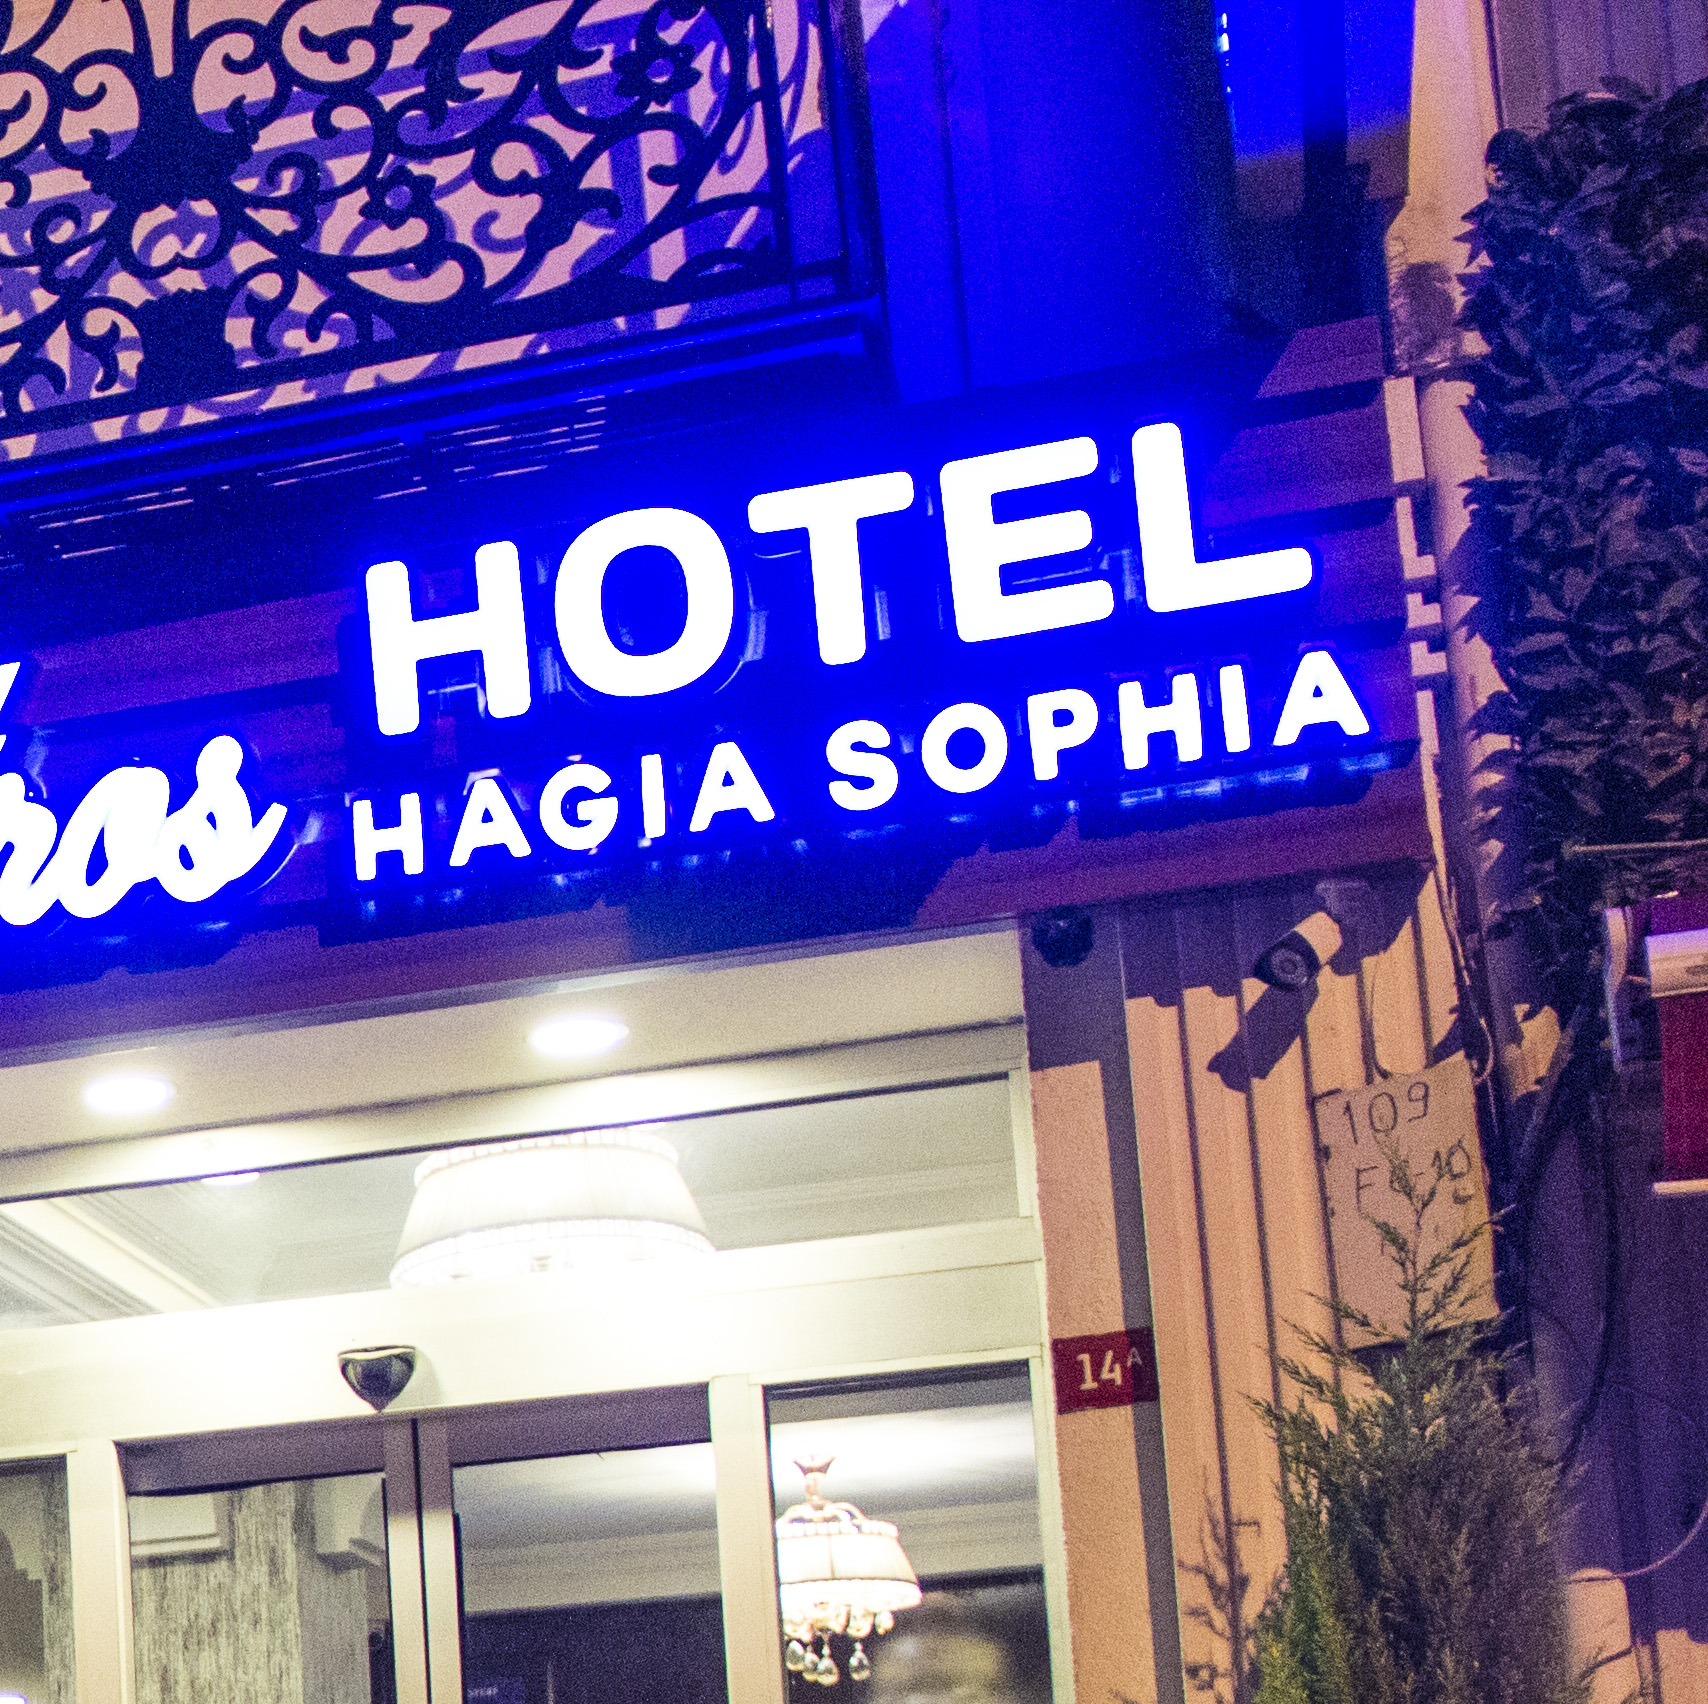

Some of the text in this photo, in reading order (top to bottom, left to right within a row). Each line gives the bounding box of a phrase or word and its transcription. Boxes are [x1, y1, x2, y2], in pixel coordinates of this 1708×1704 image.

[366, 423, 1313, 736] HOTEL
[352, 650, 1370, 881] HAGIA SOPHIA
[1343, 1081, 1430, 1145] 109
